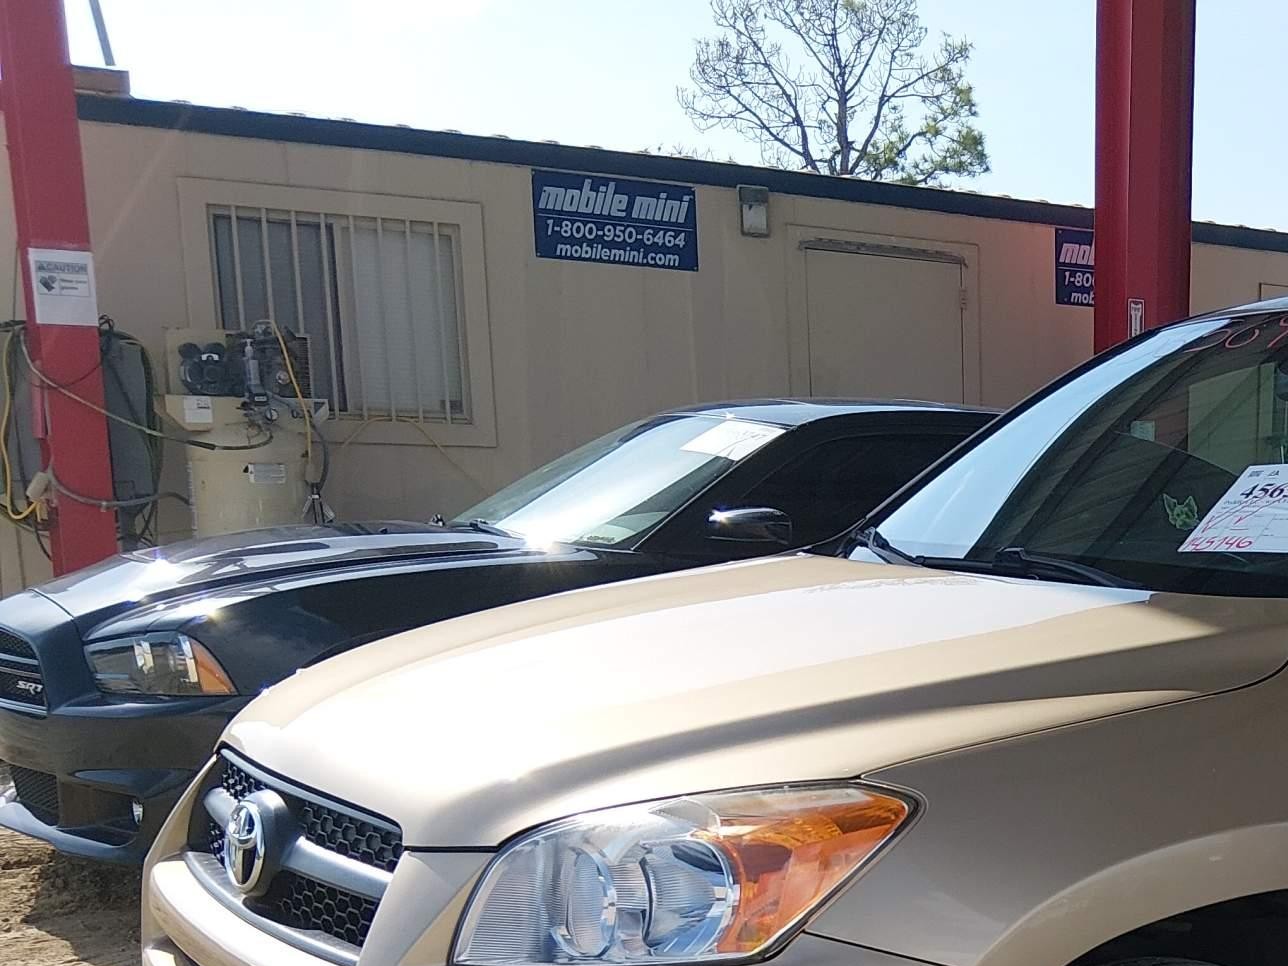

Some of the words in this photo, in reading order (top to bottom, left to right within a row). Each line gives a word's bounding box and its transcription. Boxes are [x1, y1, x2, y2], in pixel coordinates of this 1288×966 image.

[538, 179, 629, 218] mobile
[631, 193, 690, 224] mini
[546, 219, 686, 249] 1-800-950-6464
[556, 243, 680, 267] mobilemini.com
[16, 680, 44, 695] SRT
